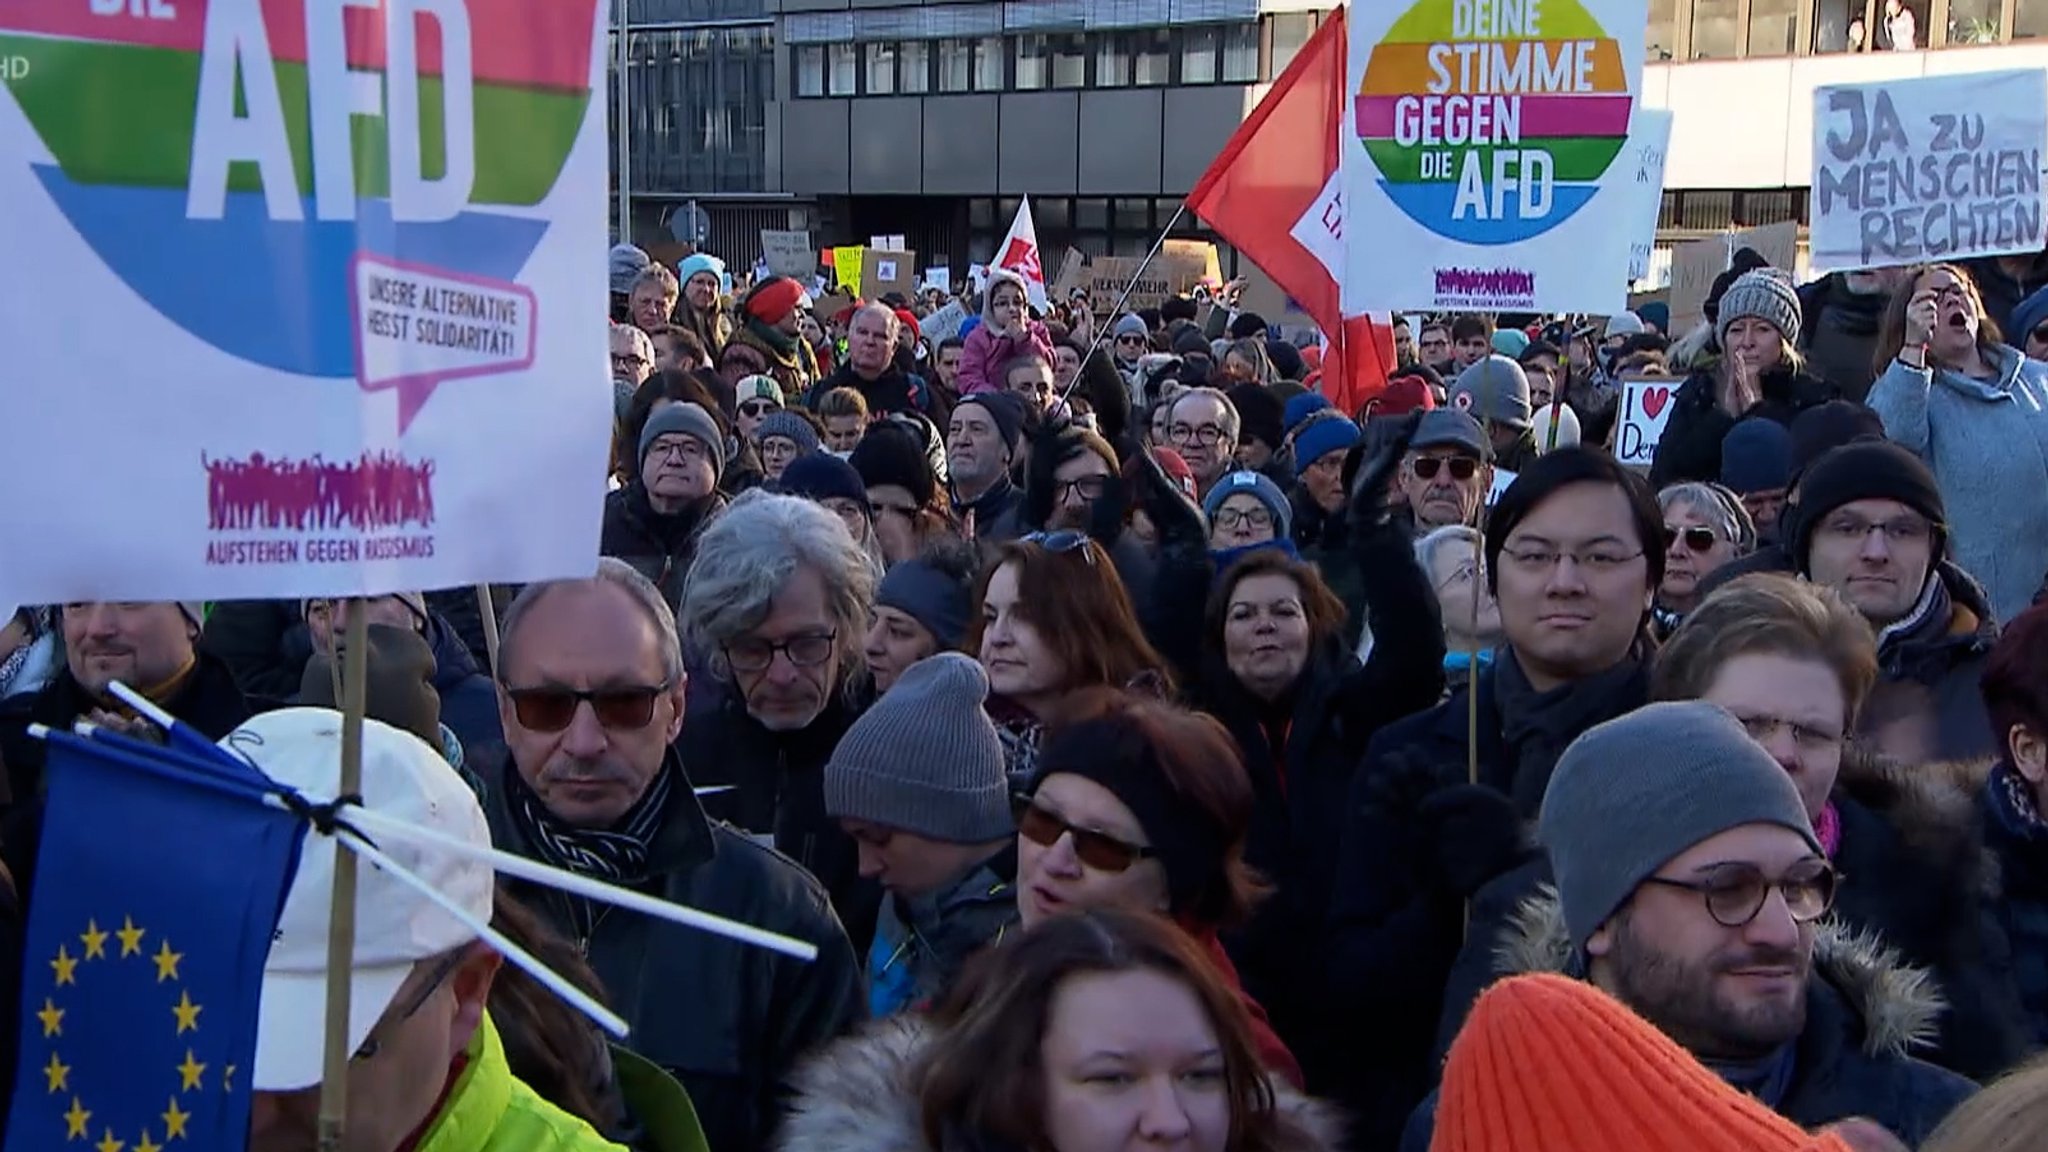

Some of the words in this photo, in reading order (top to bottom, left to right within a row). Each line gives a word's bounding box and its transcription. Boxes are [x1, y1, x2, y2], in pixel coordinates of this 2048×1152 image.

[1453, 0, 1541, 38] DEINE
[1426, 40, 1596, 94] STIMME
[186, 0, 475, 222] AFD
[1395, 95, 1522, 146] GEGEN
[1826, 89, 1909, 161] JA
[1930, 112, 1984, 151] ZU
[1421, 152, 1452, 179] DIE
[1452, 149, 1554, 220] AFD
[1819, 148, 2039, 215] MENSCHEN
[1860, 198, 2041, 265] RECHTEN
[368, 274, 417, 309] UNSERE
[422, 286, 518, 326] ALTERNATIVE
[416, 317, 515, 356] SOLIDARITÄT!
[1626, 387, 1634, 420] I
[206, 540, 298, 564] AUFSTEHEN
[305, 538, 359, 563] GEGEN
[365, 536, 434, 560] RASSISMUS
